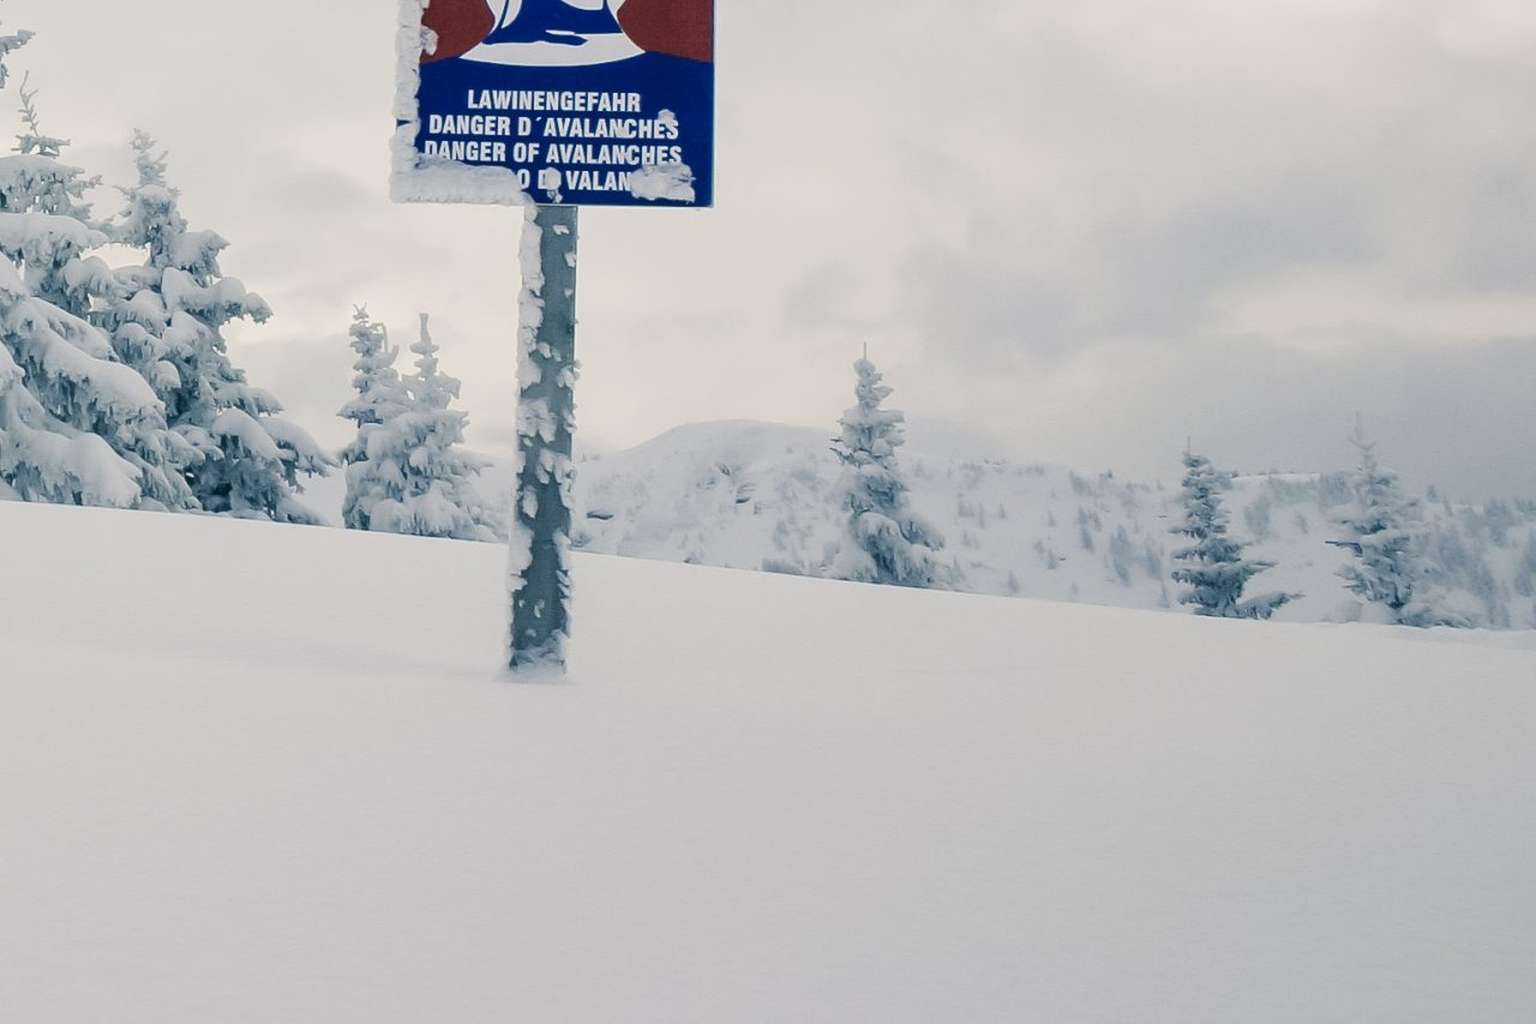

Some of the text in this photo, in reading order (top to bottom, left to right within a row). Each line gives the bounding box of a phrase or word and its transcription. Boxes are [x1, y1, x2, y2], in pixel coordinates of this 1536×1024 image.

[467, 89, 641, 112] LAWINENGEFAHR
[429, 115, 511, 136] DANGER
[424, 140, 682, 166] DANGER OF AVALANCHES
